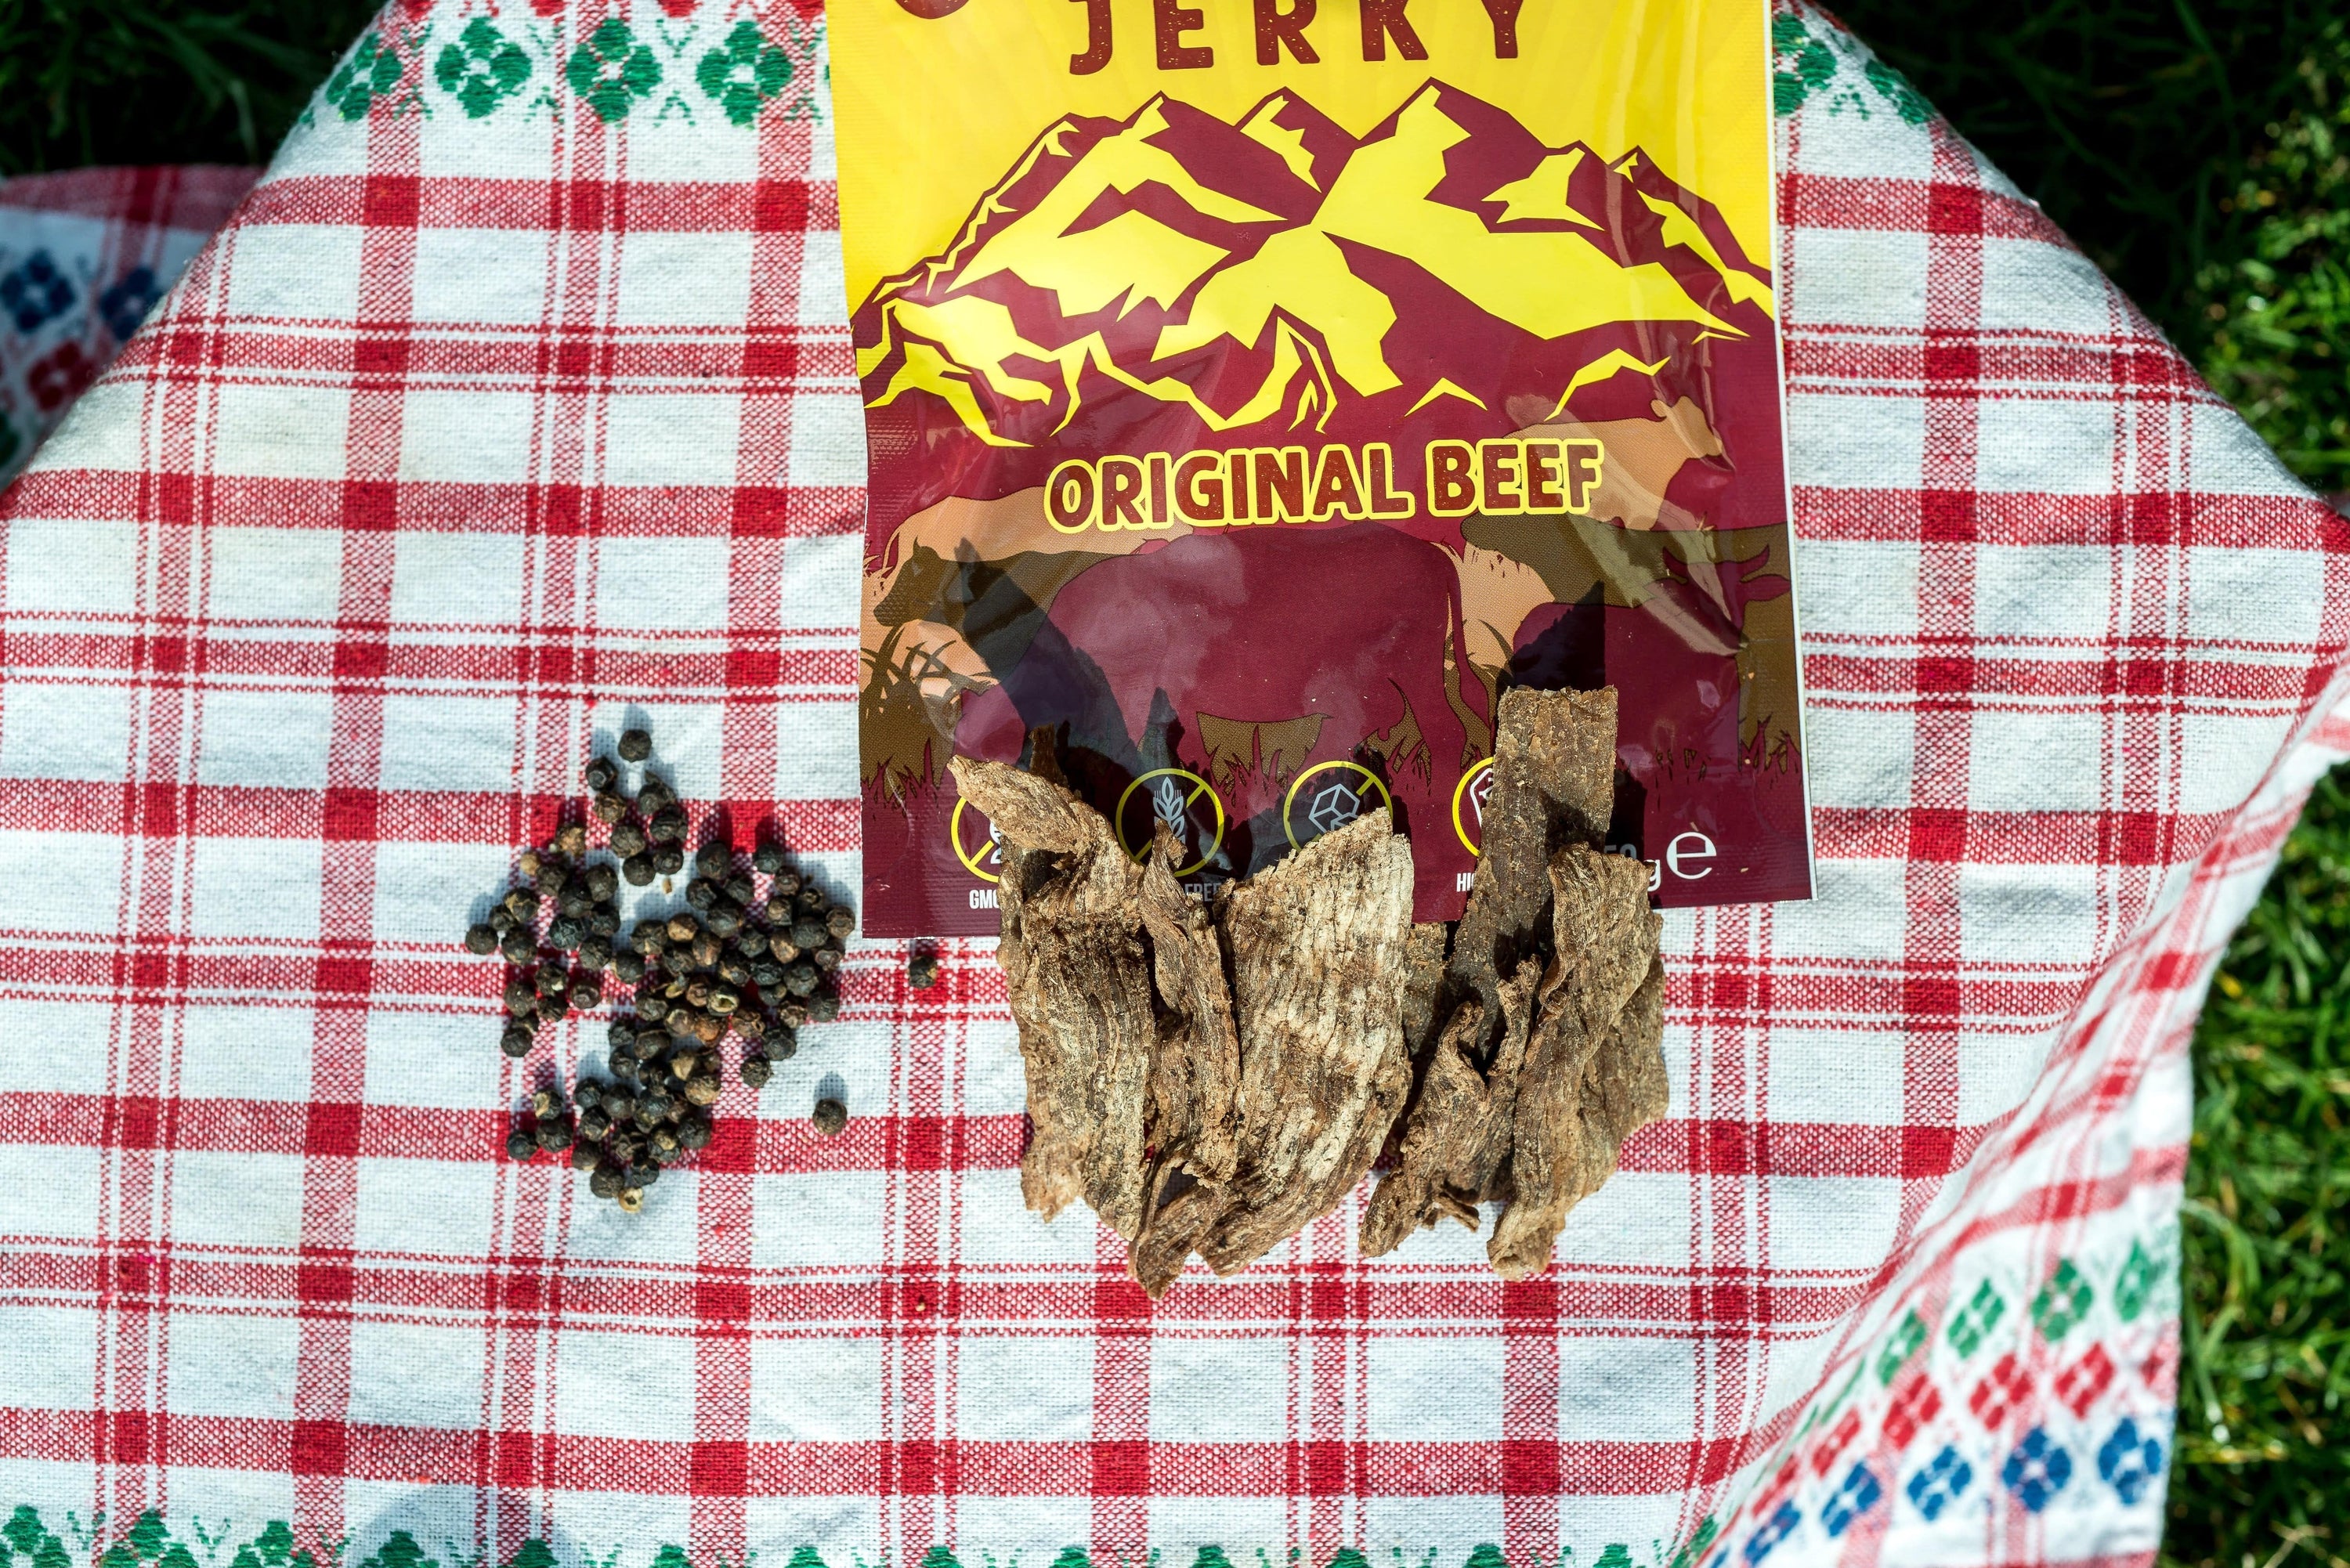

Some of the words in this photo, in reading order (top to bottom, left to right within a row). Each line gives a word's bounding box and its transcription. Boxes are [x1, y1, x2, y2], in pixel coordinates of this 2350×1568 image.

[1069, 0, 1523, 75] JERKY
[1045, 443, 1415, 533] ORIGINAL
[1426, 439, 1604, 517] BEEF
[1456, 873, 1475, 891] HI
